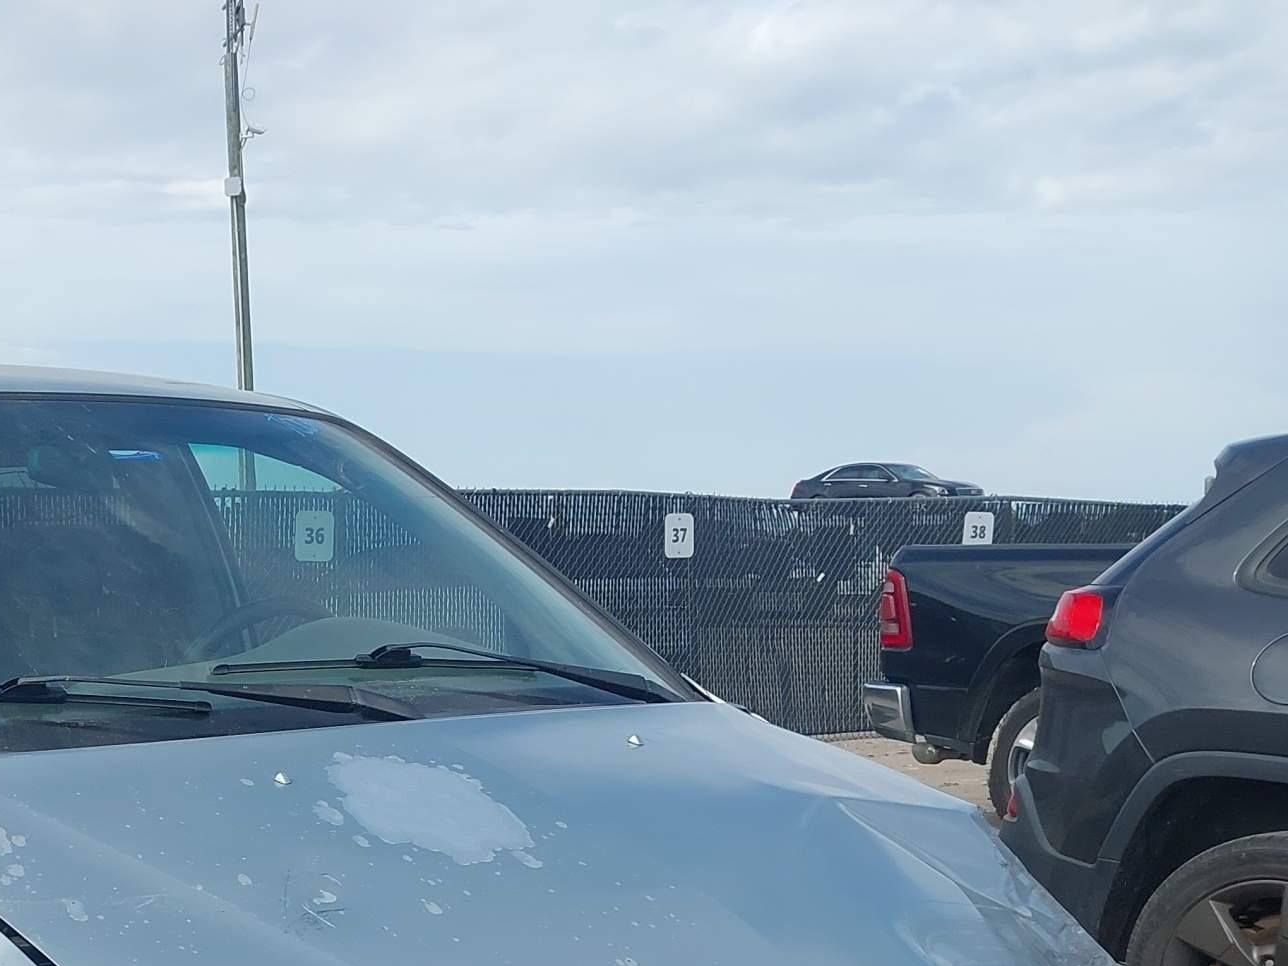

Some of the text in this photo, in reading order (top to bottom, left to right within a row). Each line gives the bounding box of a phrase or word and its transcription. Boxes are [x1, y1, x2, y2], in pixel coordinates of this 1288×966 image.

[304, 527, 325, 545] 36
[671, 527, 688, 543] 37
[970, 525, 986, 539] 38
